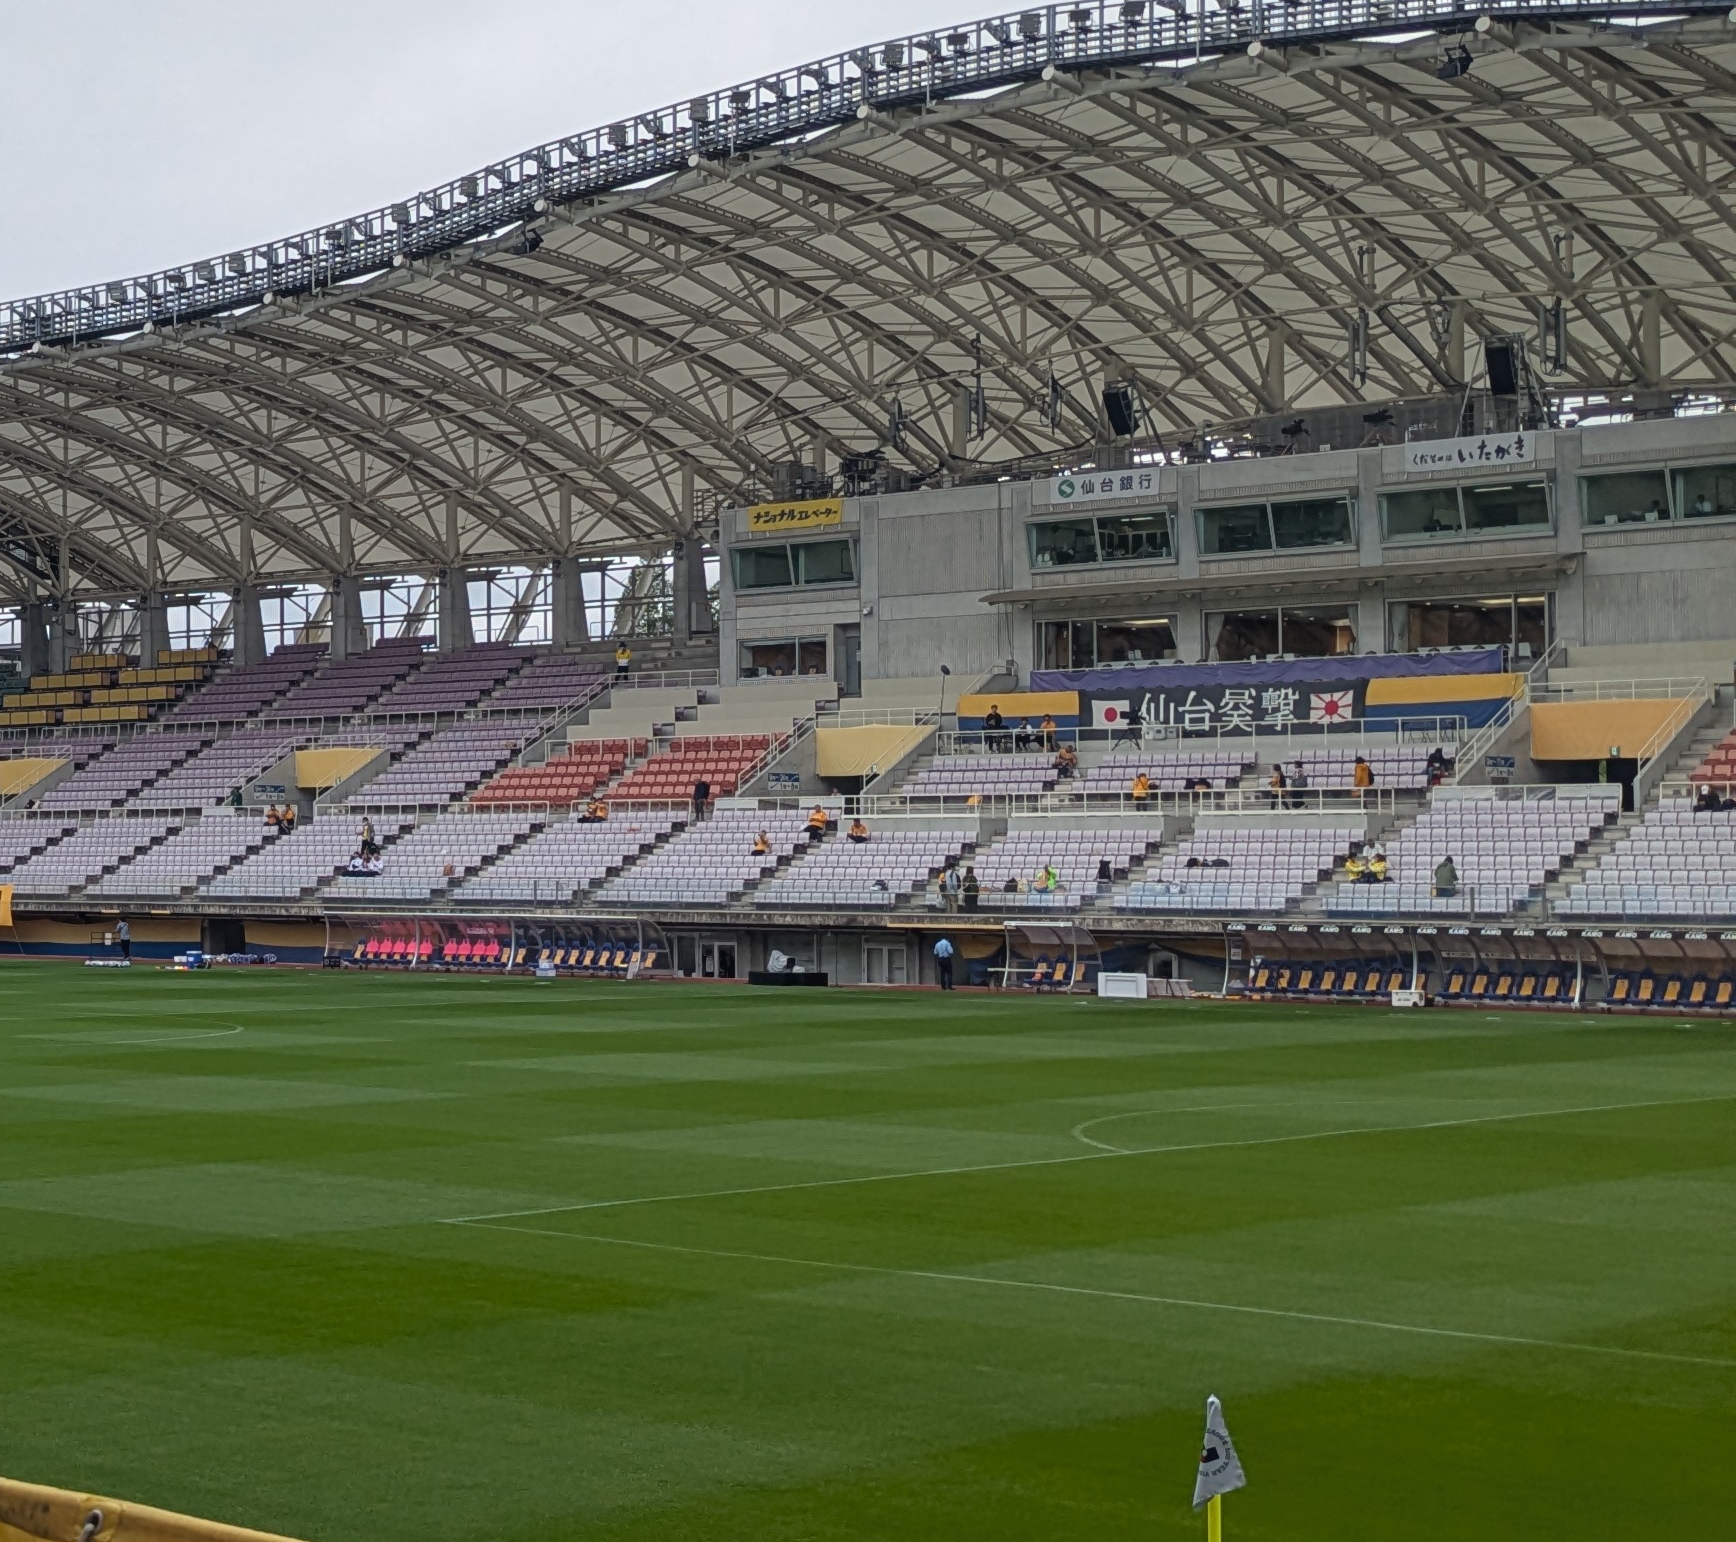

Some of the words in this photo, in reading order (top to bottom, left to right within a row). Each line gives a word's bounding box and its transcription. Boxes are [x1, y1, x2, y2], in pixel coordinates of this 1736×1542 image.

[1457, 434, 1524, 463] いたがき
[1081, 474, 1152, 495] 仙台銀行
[753, 508, 838, 524] ナショナルエレベーター
